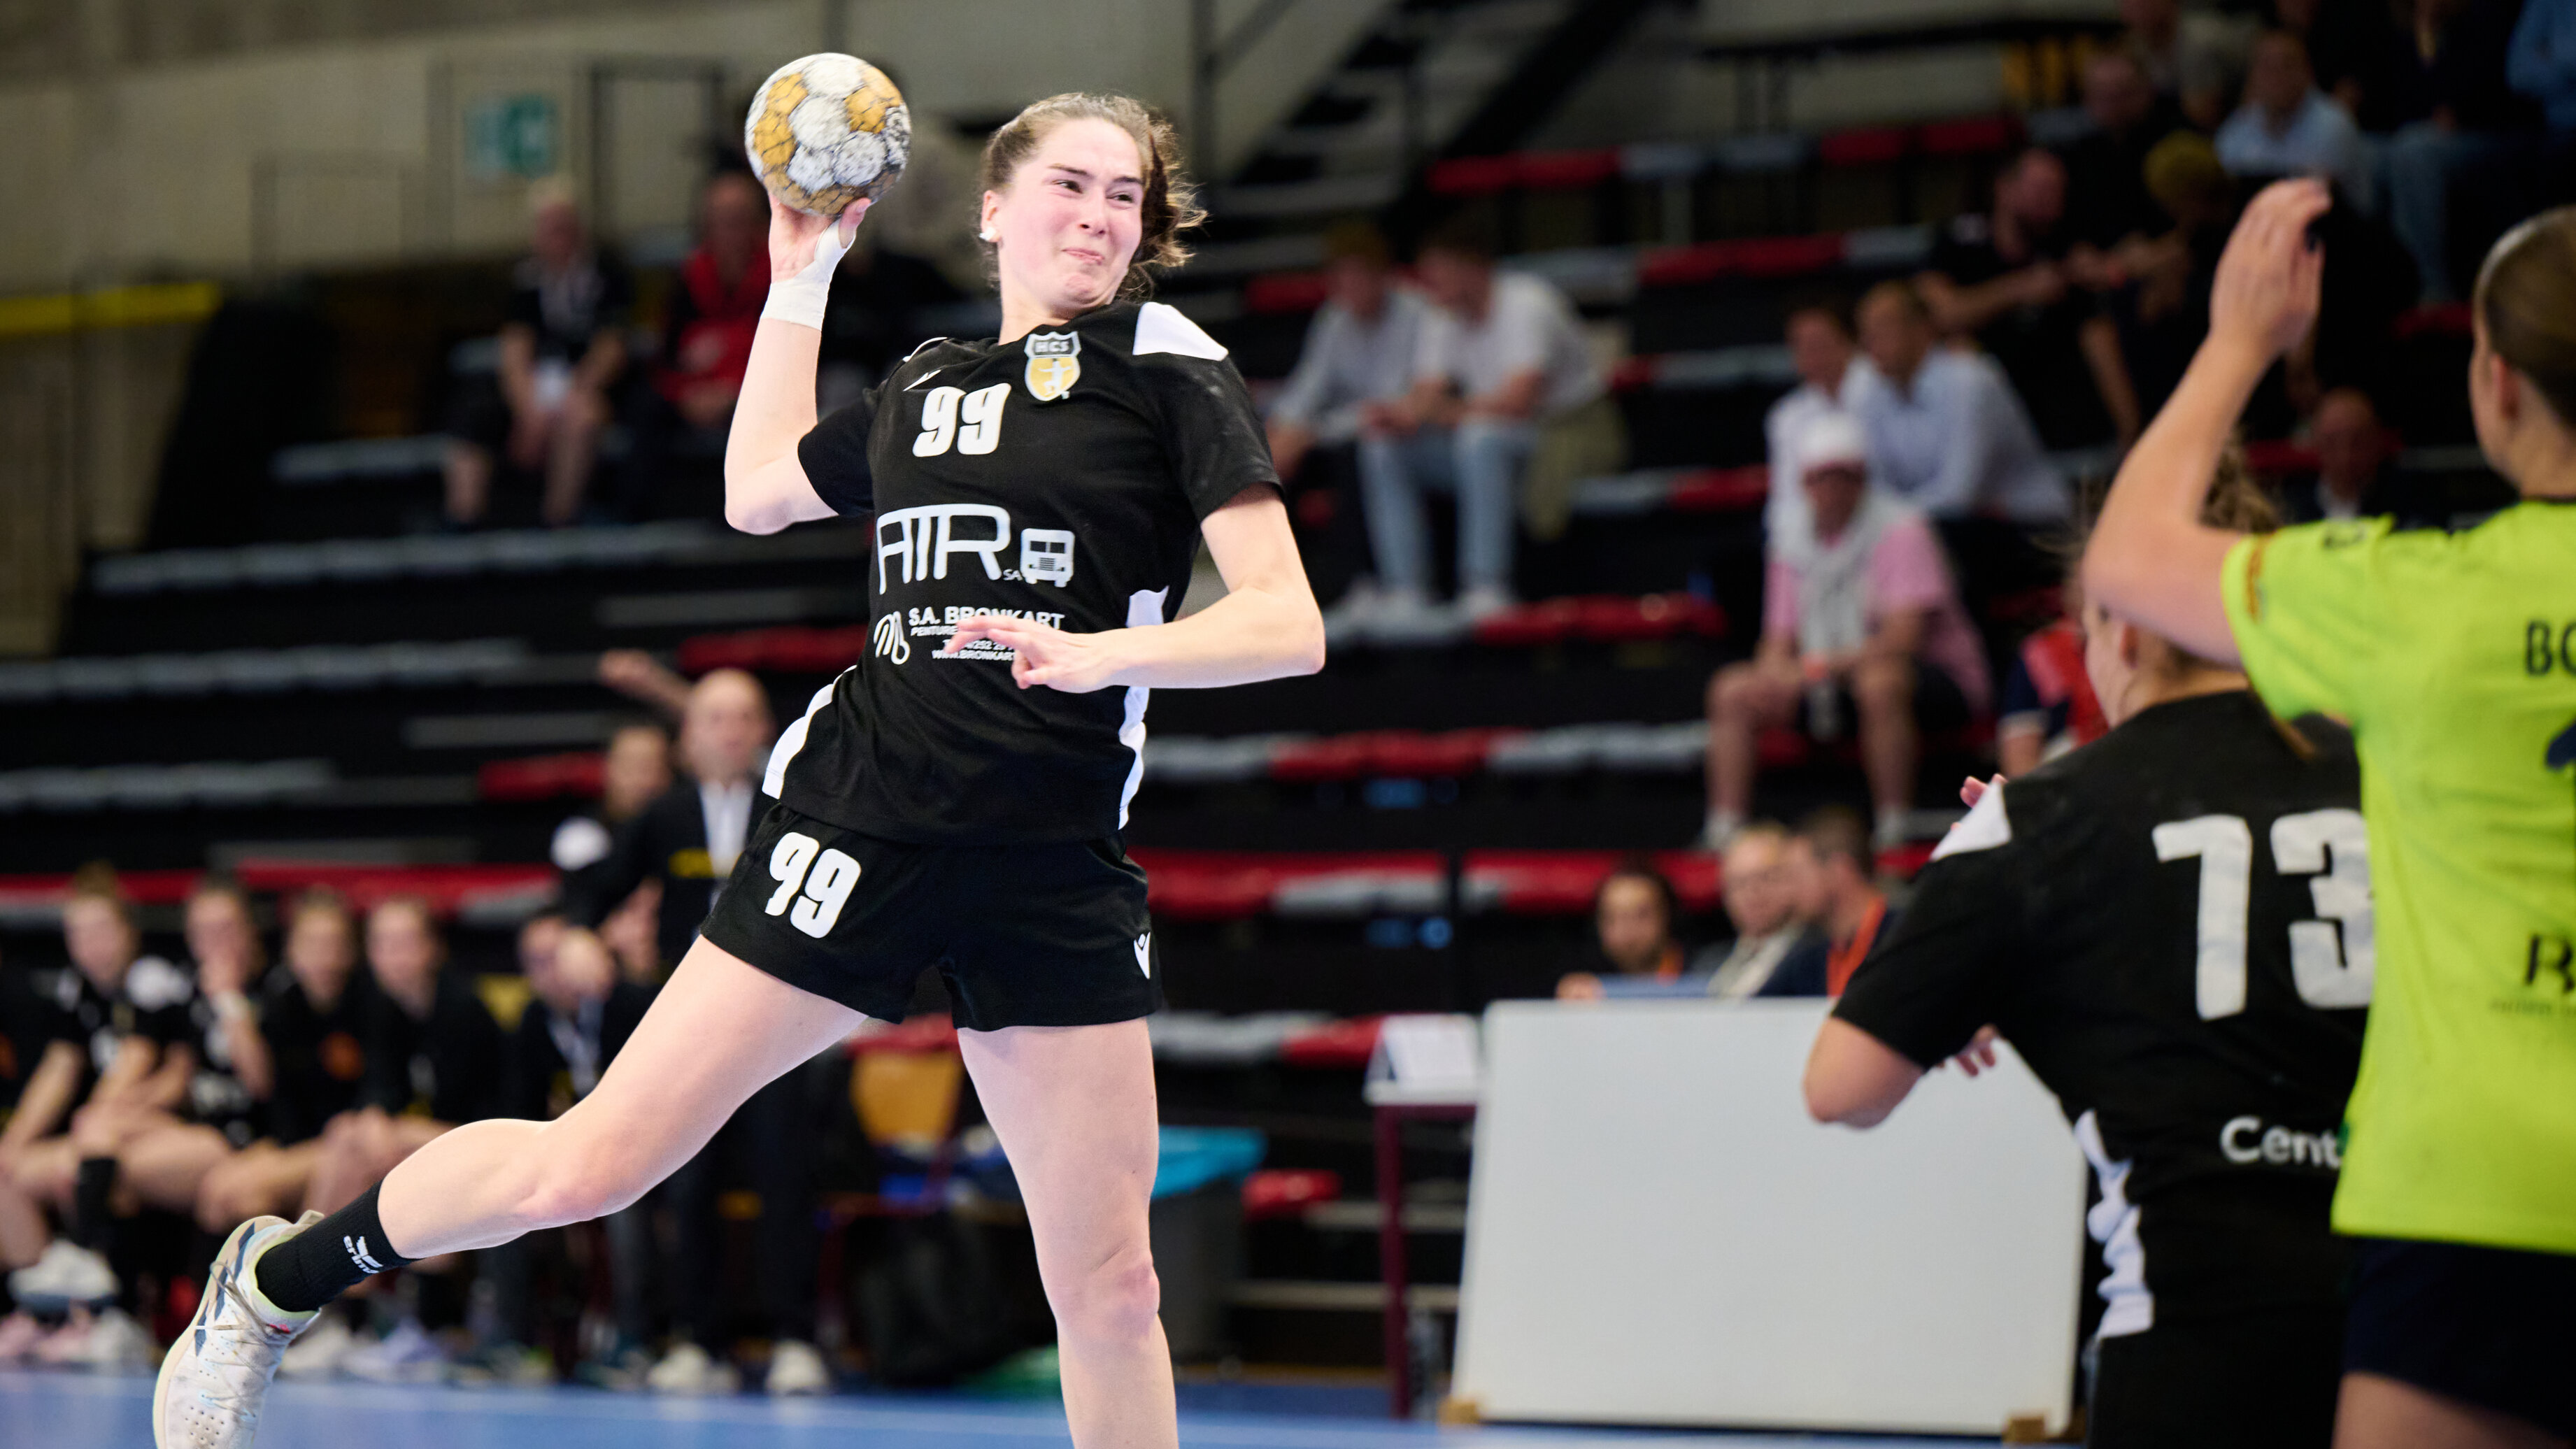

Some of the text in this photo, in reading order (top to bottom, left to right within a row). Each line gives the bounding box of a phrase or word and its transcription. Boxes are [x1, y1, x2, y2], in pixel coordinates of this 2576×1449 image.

[1035, 341, 1069, 352] HCS
[913, 383, 1011, 457] 99
[876, 504, 1011, 594] ATR
[1003, 569, 1023, 581] SA
[909, 606, 941, 626] S.A.
[764, 831, 862, 938] 99
[2152, 808, 2375, 1021] 73
